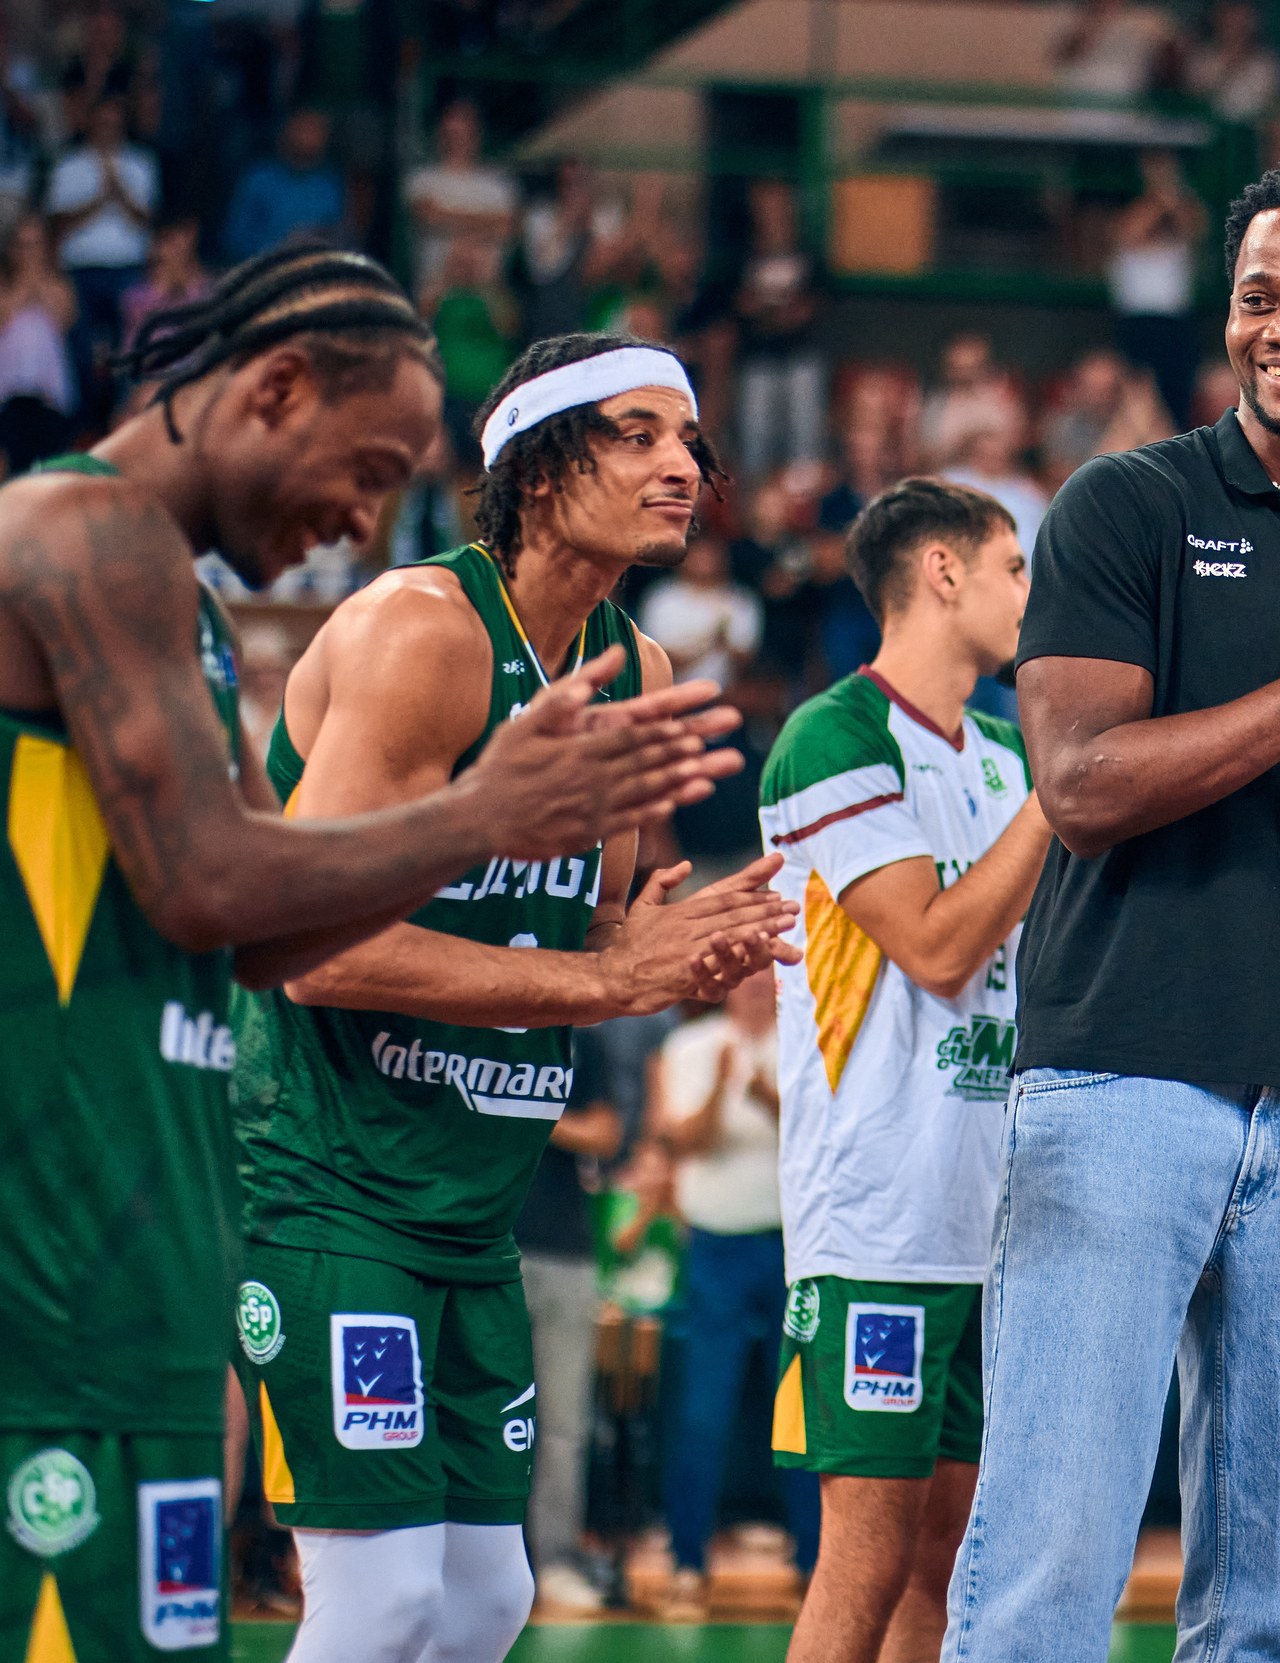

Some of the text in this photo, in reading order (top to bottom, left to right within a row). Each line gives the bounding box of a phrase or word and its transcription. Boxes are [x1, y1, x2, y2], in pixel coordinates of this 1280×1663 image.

[1187, 534, 1239, 552] CRAFT
[851, 1380, 915, 1397] PHM
[343, 1411, 418, 1431] PHM
[383, 1431, 419, 1441] GROUP
